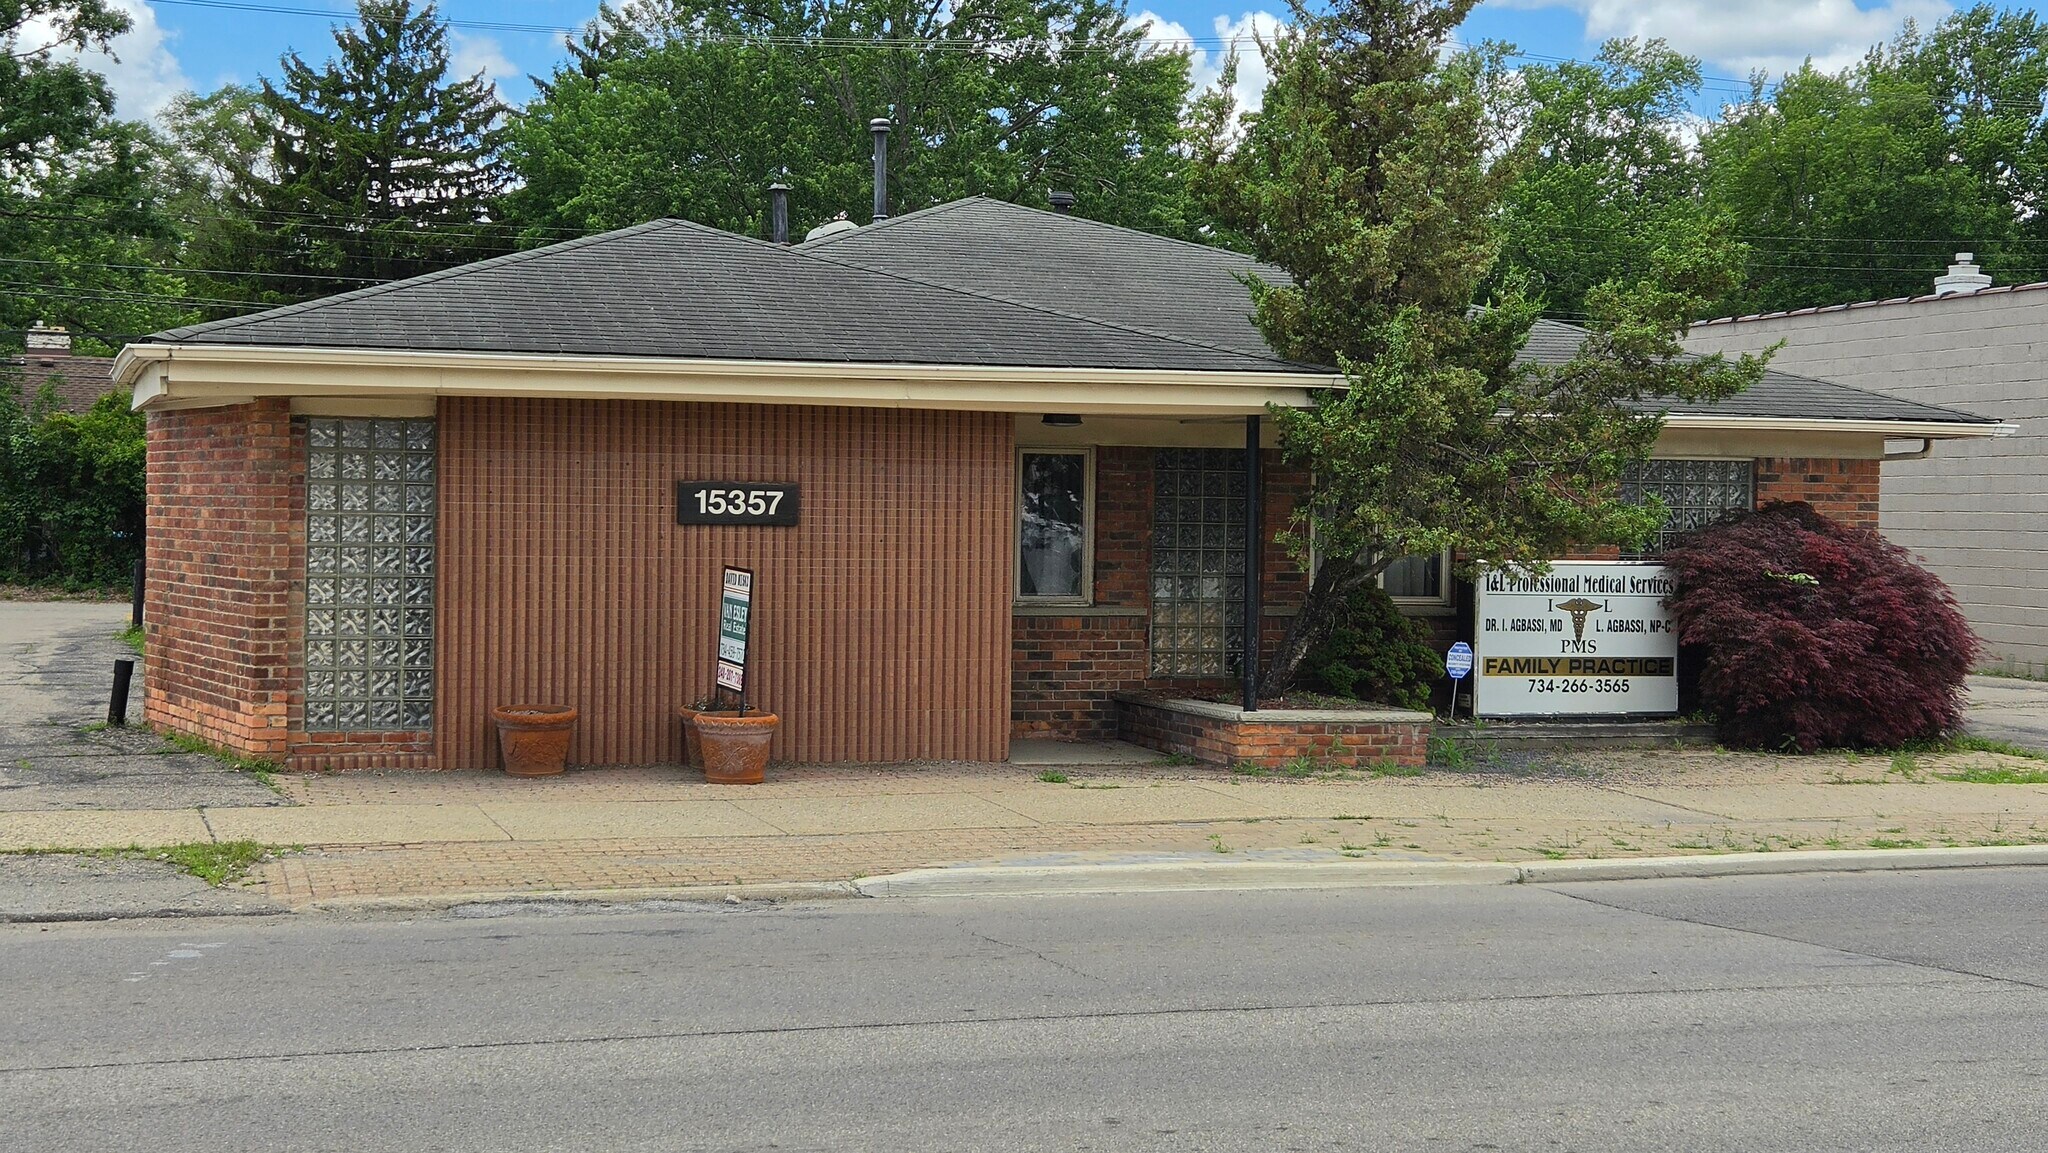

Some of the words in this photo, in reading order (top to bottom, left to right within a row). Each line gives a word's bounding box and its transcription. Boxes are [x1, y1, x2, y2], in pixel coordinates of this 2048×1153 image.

[694, 489, 784, 515] 15357
[1486, 573, 1505, 592] I&L
[1583, 575, 1626, 594] Medical
[1630, 575, 1674, 594] Services
[1548, 599, 1553, 613] I
[1604, 599, 1613, 613] L
[1485, 618, 1500, 632] DR.
[1502, 618, 1508, 632] I.
[1510, 618, 1547, 635] AGBASSI,
[1549, 618, 1563, 632] MD
[1596, 619, 1604, 633] L.
[1607, 619, 1647, 636] AGBASSI,
[1650, 619, 1671, 634] NP-C
[1560, 639, 1597, 654] PMS
[1485, 658, 1559, 674] FAMILY
[1569, 659, 1671, 674] PRACTICE
[1528, 679, 1630, 693] 734-266-3565
